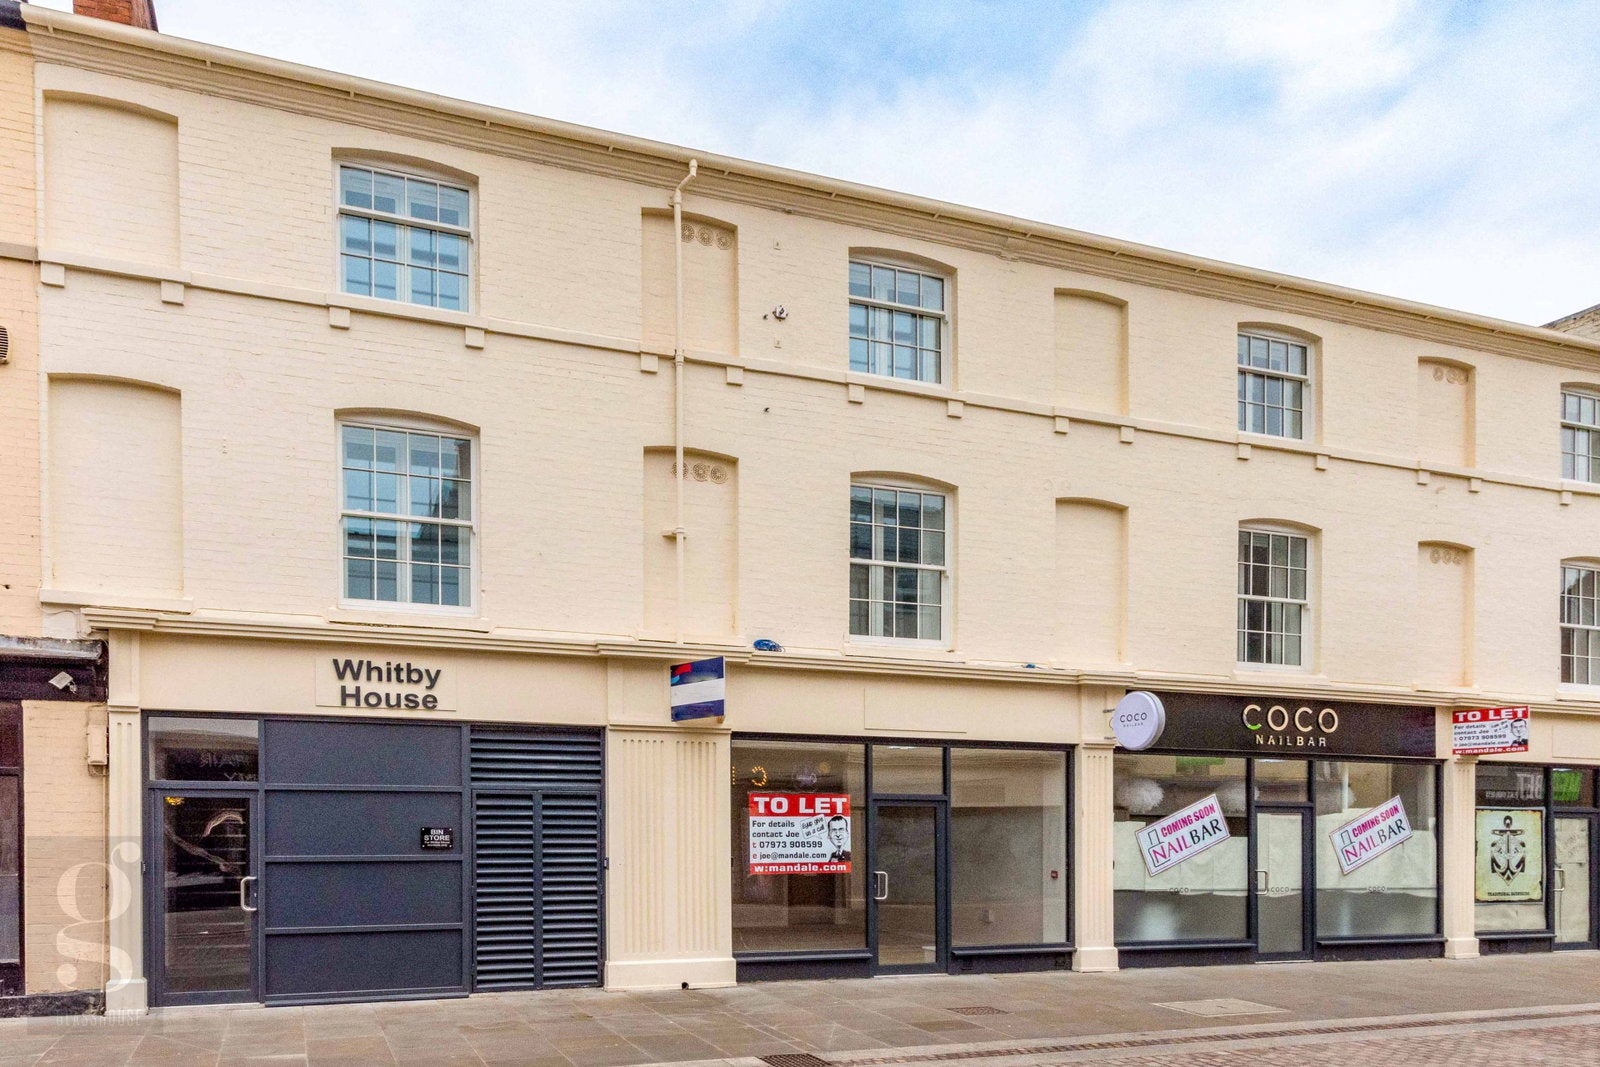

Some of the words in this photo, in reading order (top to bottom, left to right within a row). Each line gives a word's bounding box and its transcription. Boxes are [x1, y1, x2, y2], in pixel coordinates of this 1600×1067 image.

[332, 658, 441, 690] Whitby
[340, 685, 438, 709] House
[1119, 712, 1148, 723] COCO
[1242, 704, 1339, 733] COCO
[1455, 711, 1481, 721] TO
[1488, 708, 1526, 720] LET
[1455, 746, 1526, 754] w:mandale.com
[753, 797, 789, 814] TO
[799, 797, 848, 814] LET
[752, 820, 766, 828] For
[768, 820, 795, 828] details
[1160, 814, 1194, 838] COMING
[1193, 803, 1216, 821] SOON
[1352, 815, 1381, 838] COMING
[1380, 804, 1400, 822] SOON
[785, 830, 800, 838] Joe
[759, 851, 827, 860] joe@mandale.com
[754, 863, 847, 872] w:mandale.com
